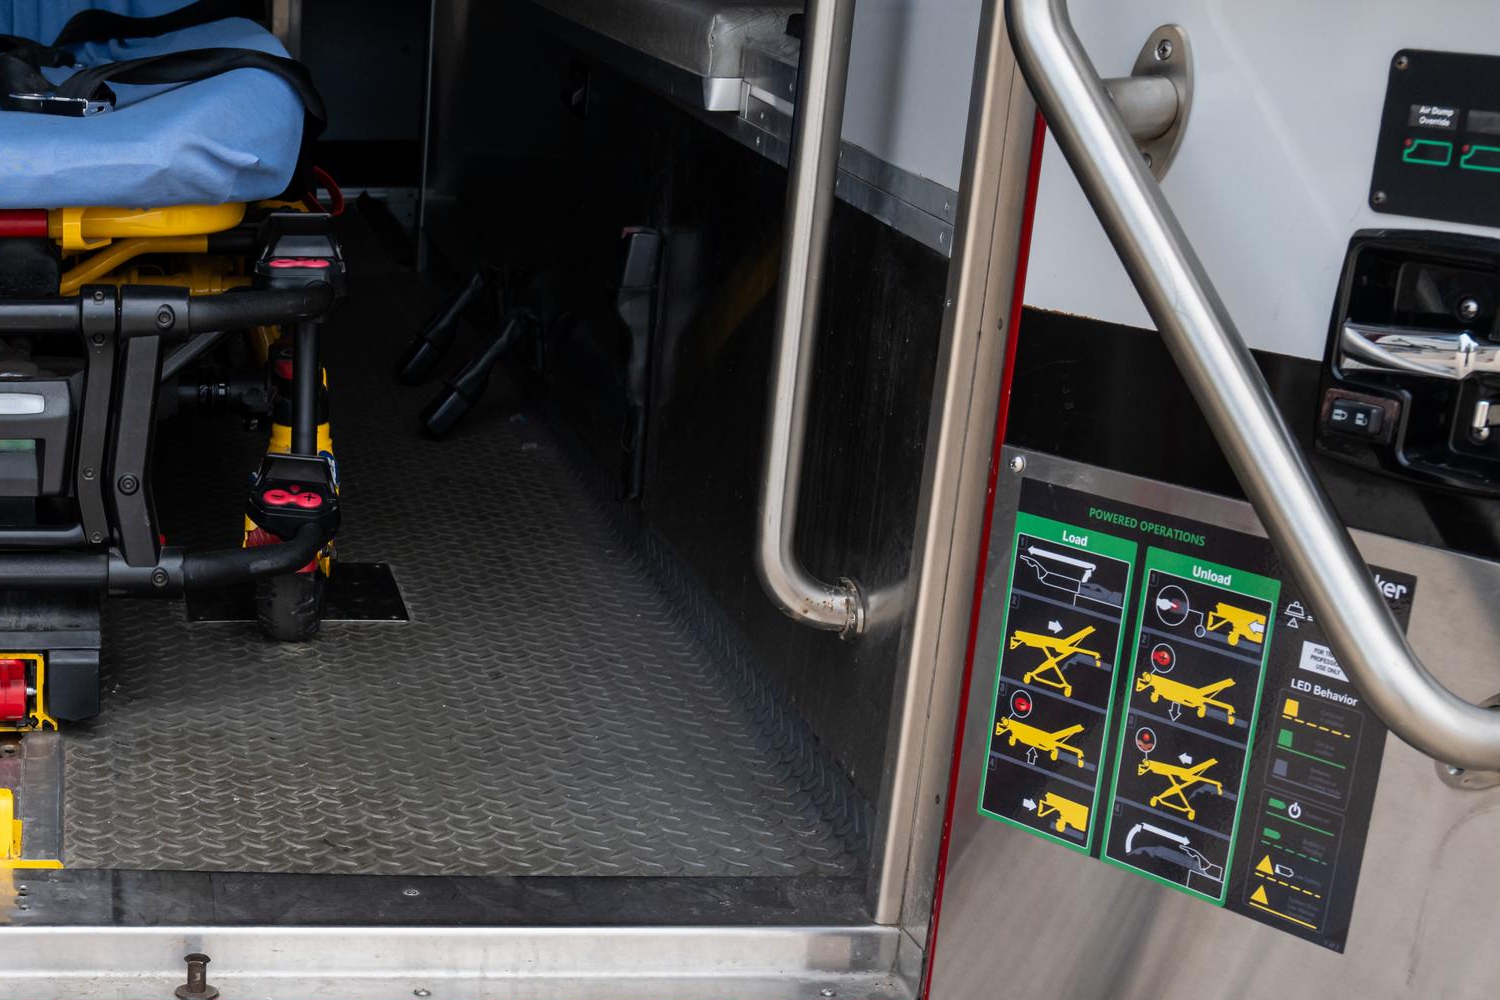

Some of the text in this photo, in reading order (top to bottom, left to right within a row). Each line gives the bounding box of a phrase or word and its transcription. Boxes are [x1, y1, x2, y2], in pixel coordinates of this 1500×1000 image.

[1062, 530, 1088, 547] Load
[1088, 507, 1206, 547] POWERED OPERATIONS
[1192, 564, 1232, 586] Unload
[1290, 678, 1358, 706] LED Behavior
